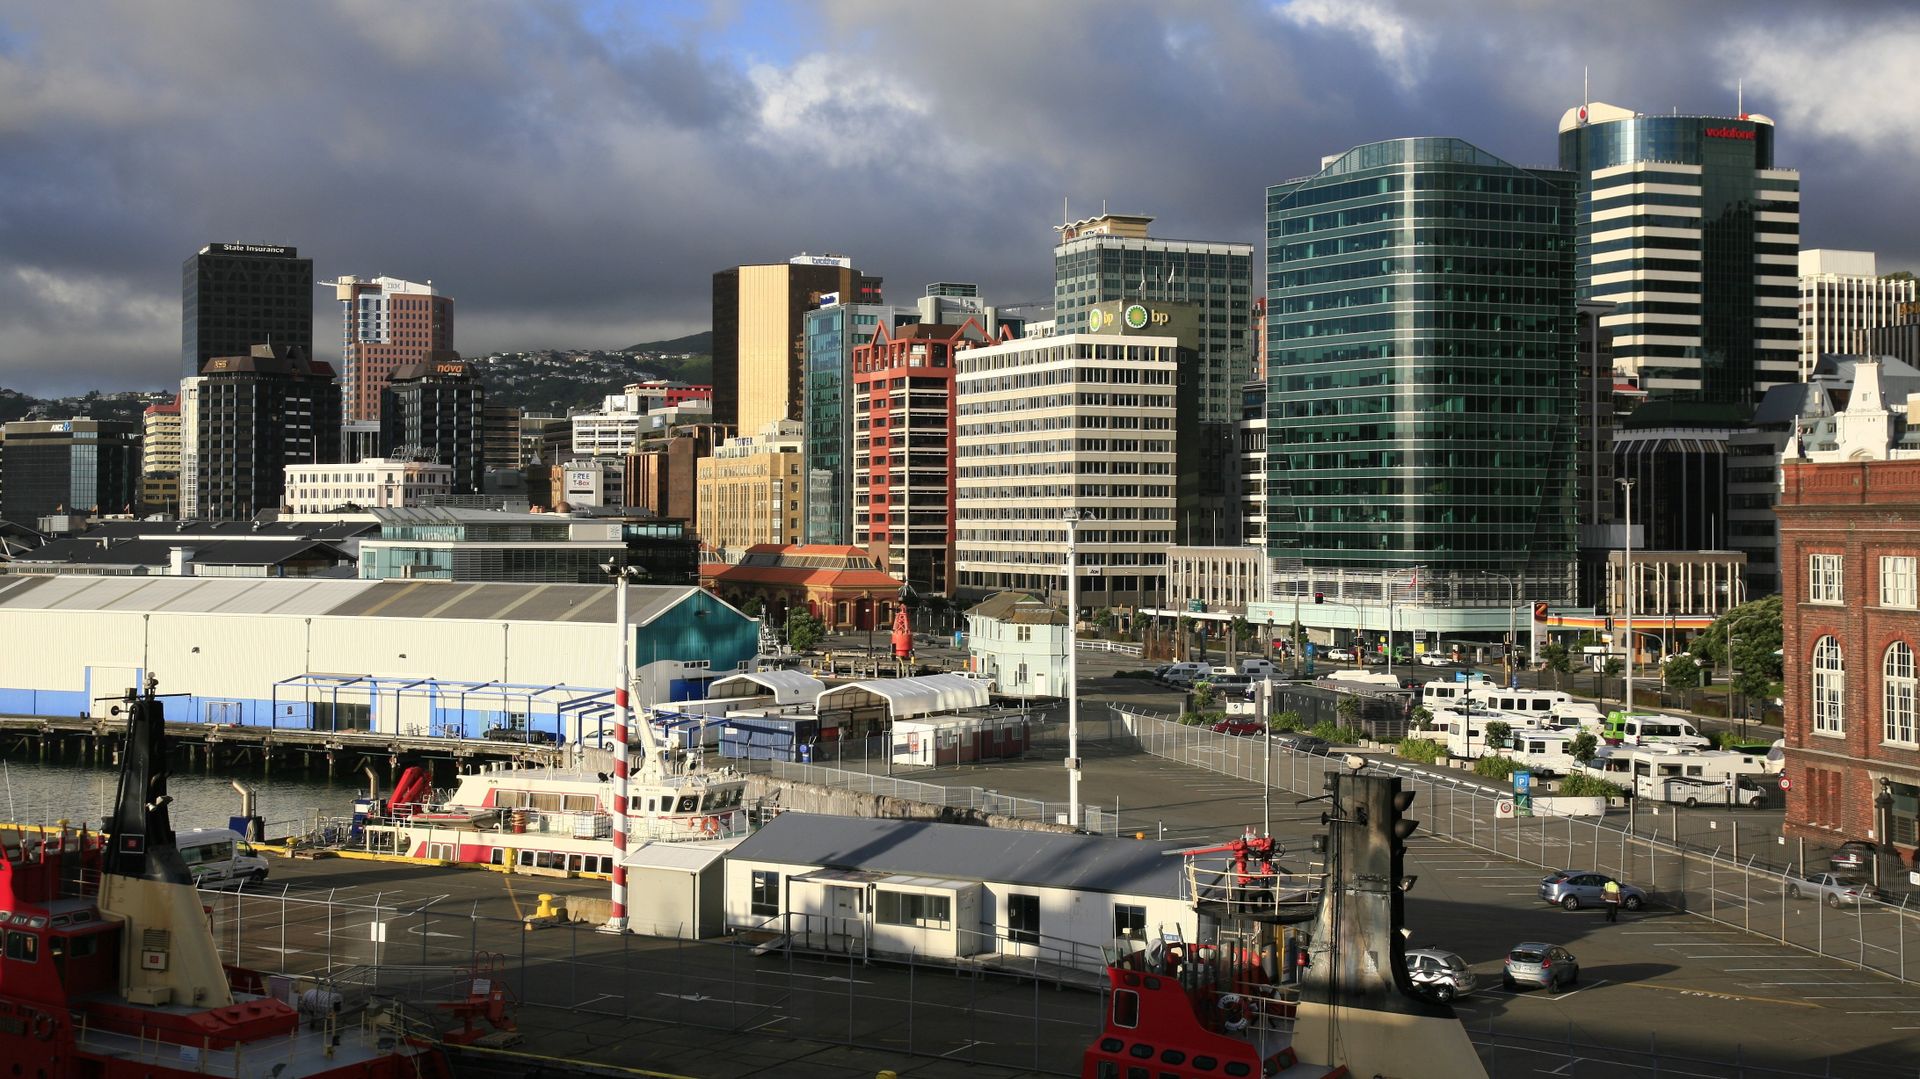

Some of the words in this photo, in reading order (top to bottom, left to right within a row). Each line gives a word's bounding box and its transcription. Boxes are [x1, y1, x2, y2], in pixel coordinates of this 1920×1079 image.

[1705, 127, 1756, 139] vodafone
[246, 245, 285, 253] Insurance
[1103, 306, 1113, 326] bp
[1151, 309, 1169, 326] bp
[437, 363, 463, 373] nova
[50, 424, 64, 432] ANZ
[735, 437, 753, 446] TOWER
[1536, 604, 1547, 617] Z
[1679, 990, 1745, 1001] ENTRY
